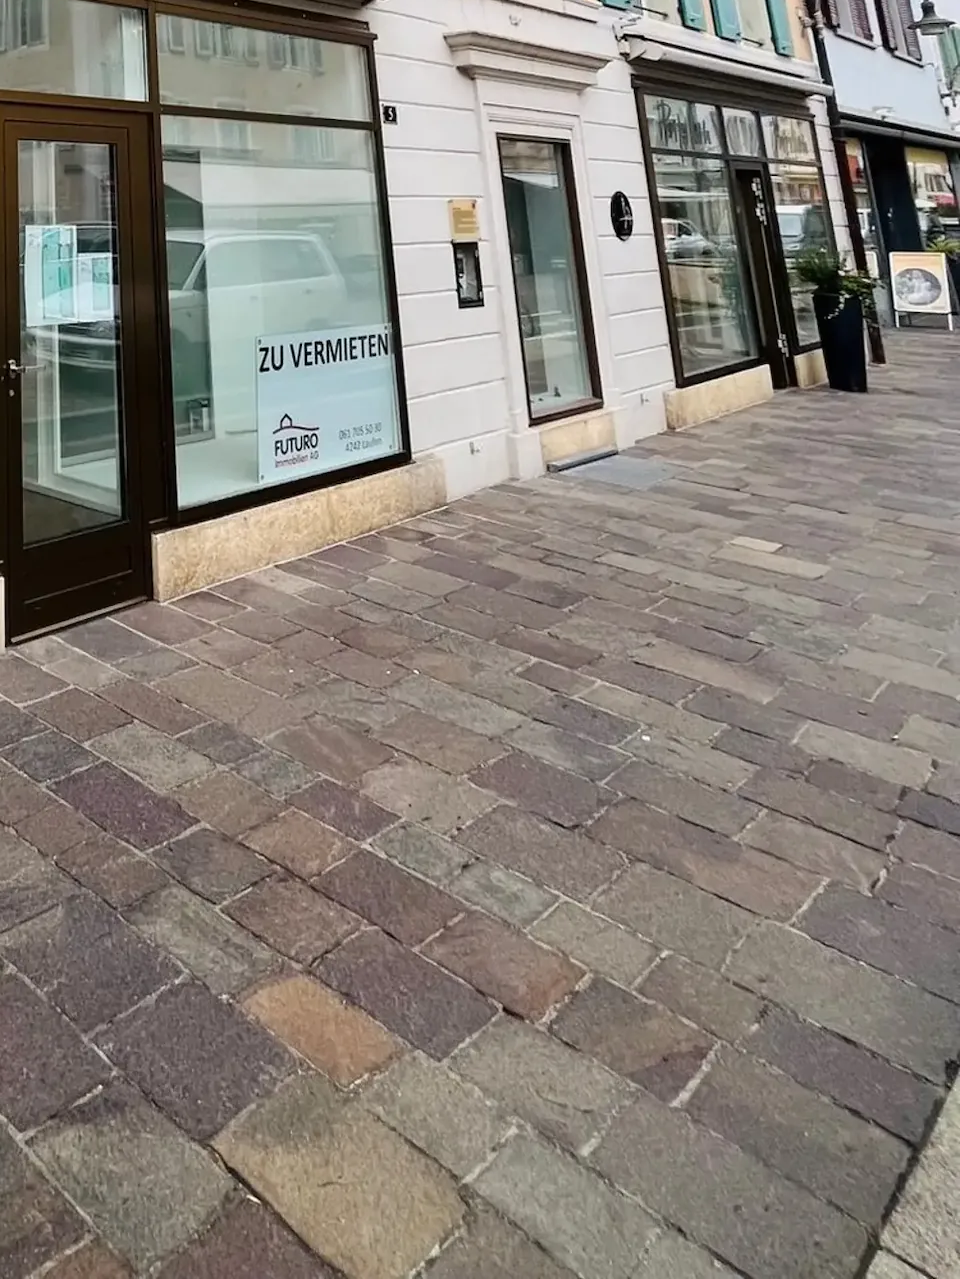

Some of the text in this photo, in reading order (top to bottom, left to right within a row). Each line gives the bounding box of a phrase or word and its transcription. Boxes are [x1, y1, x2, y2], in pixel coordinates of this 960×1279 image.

[258, 333, 389, 373] ZU VERMIETEN
[274, 432, 319, 457] FUTURO
